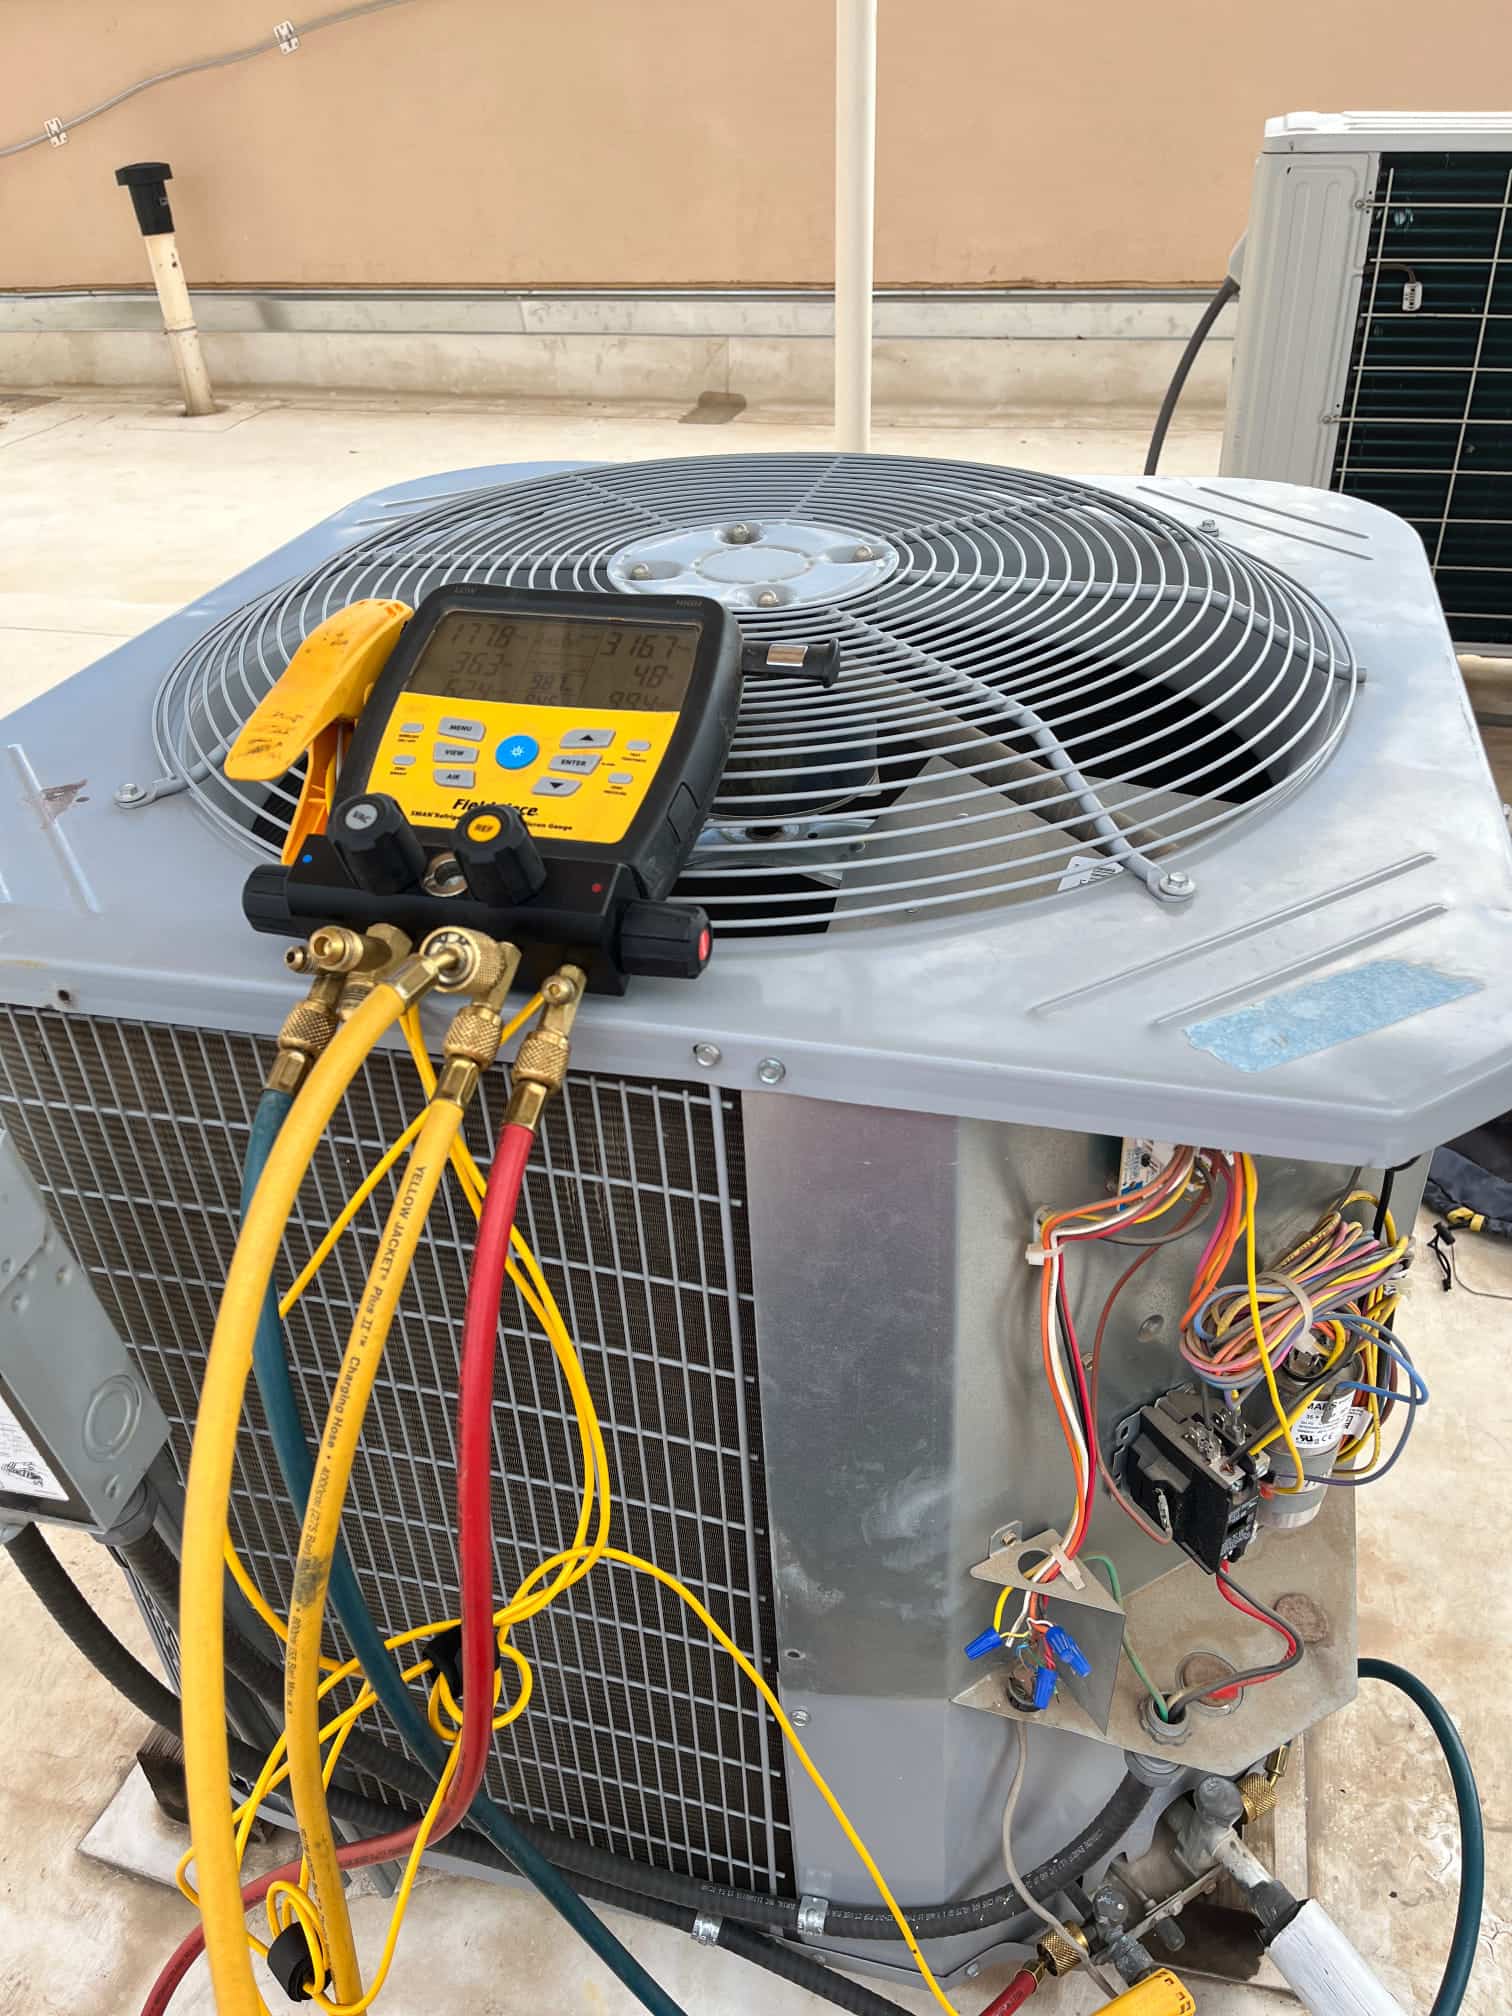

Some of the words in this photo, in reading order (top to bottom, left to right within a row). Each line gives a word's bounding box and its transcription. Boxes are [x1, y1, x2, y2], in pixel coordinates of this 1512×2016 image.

[449, 724, 473, 732] MENU
[560, 758, 586, 767] ENTER
[399, 1166, 425, 1219] YELLOW
[366, 1285, 383, 1314] Plus
[335, 1356, 360, 1415] Charging
[327, 1417, 343, 1448] Hose
